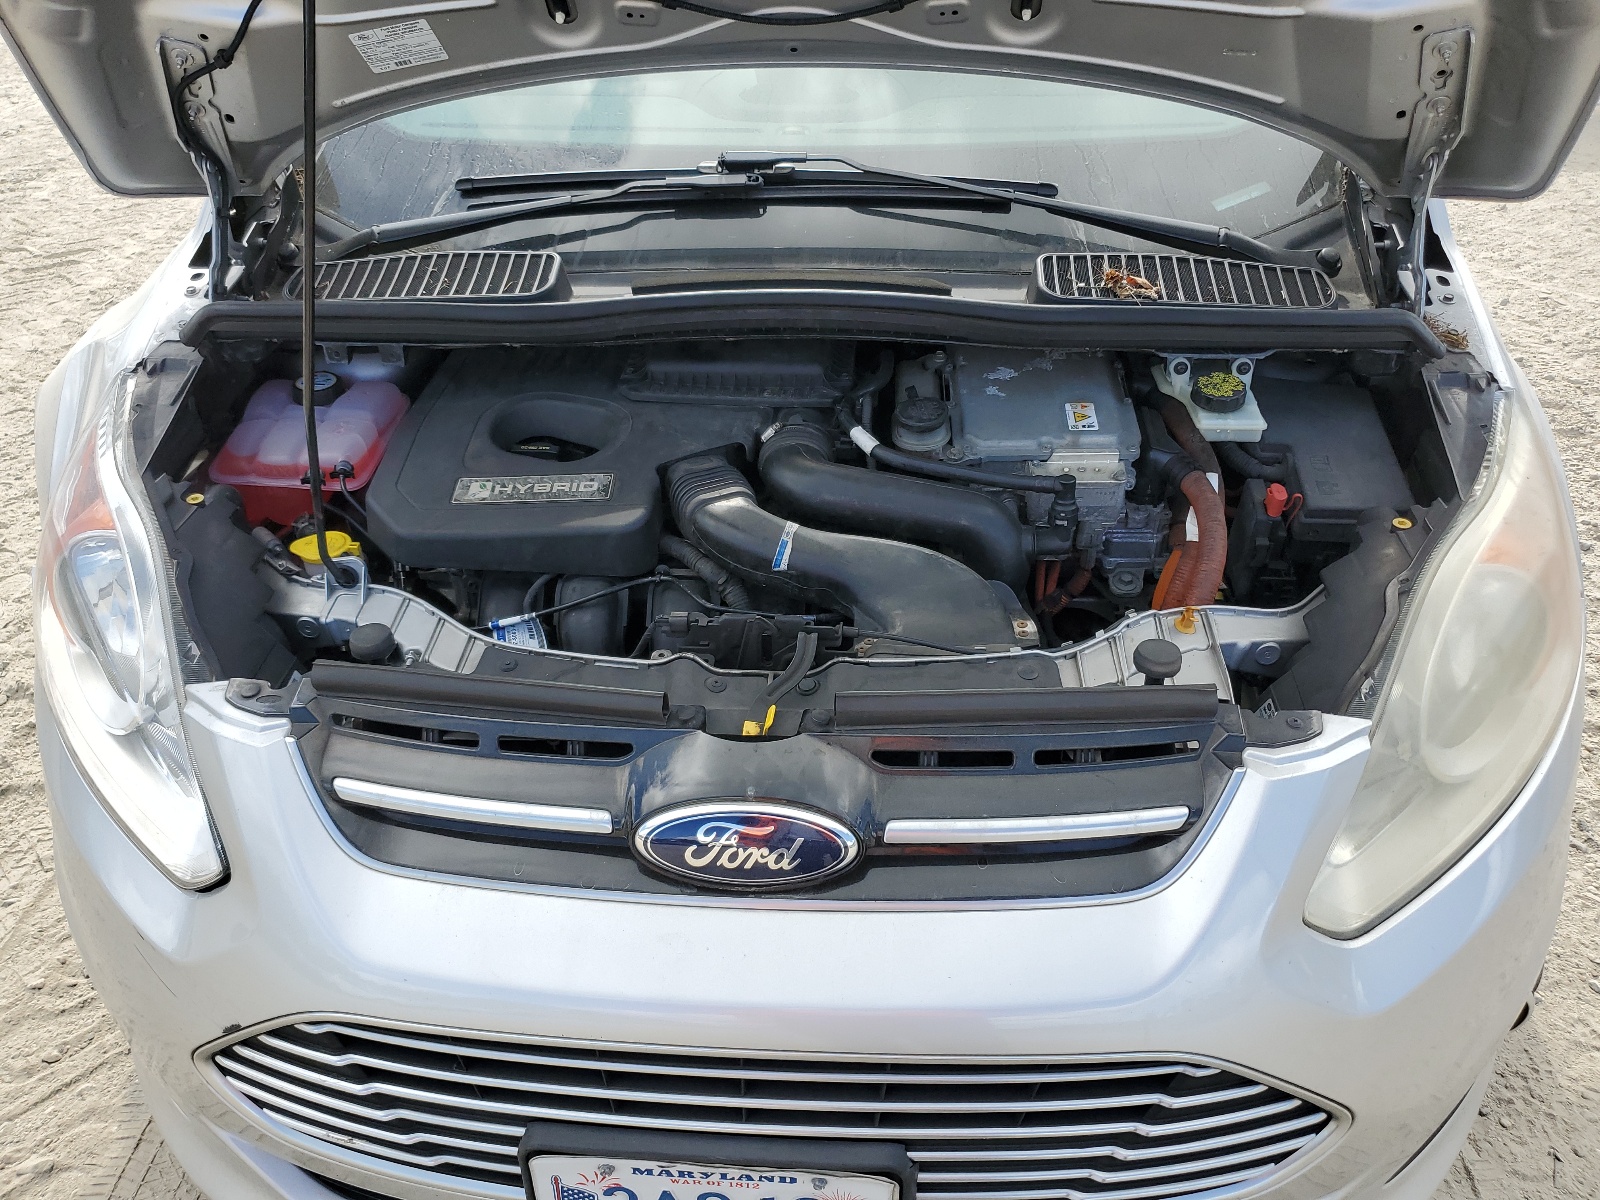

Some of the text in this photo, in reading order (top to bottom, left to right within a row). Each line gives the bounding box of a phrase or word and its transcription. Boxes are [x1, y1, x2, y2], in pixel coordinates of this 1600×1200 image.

[493, 481, 599, 495] HYBRID
[684, 821, 803, 871] Ford
[631, 1167, 798, 1184] MARYLAND
[729, 1181, 760, 1189] 1812
